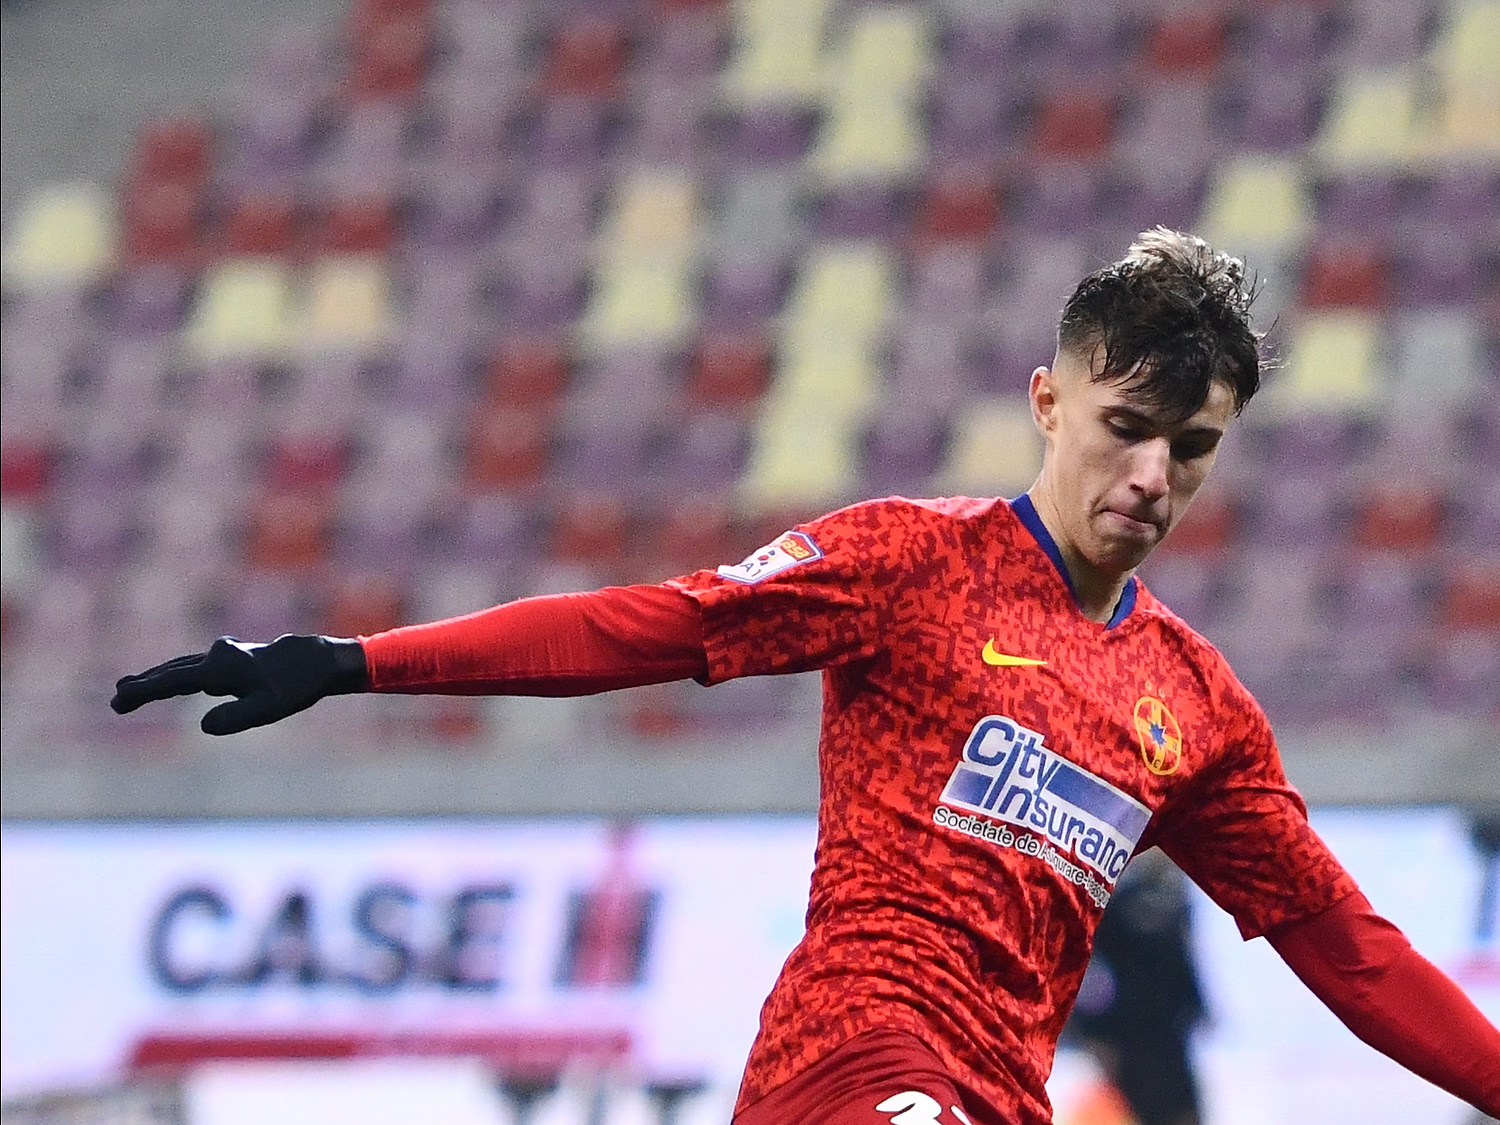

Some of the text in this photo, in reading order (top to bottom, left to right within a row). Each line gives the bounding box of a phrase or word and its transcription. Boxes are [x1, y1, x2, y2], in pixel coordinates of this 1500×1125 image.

[966, 720, 1062, 797] City
[934, 807, 1012, 845] Societate
[1016, 834, 1038, 853] de
[983, 741, 1129, 879] Insuranc
[147, 880, 520, 992] CASE
